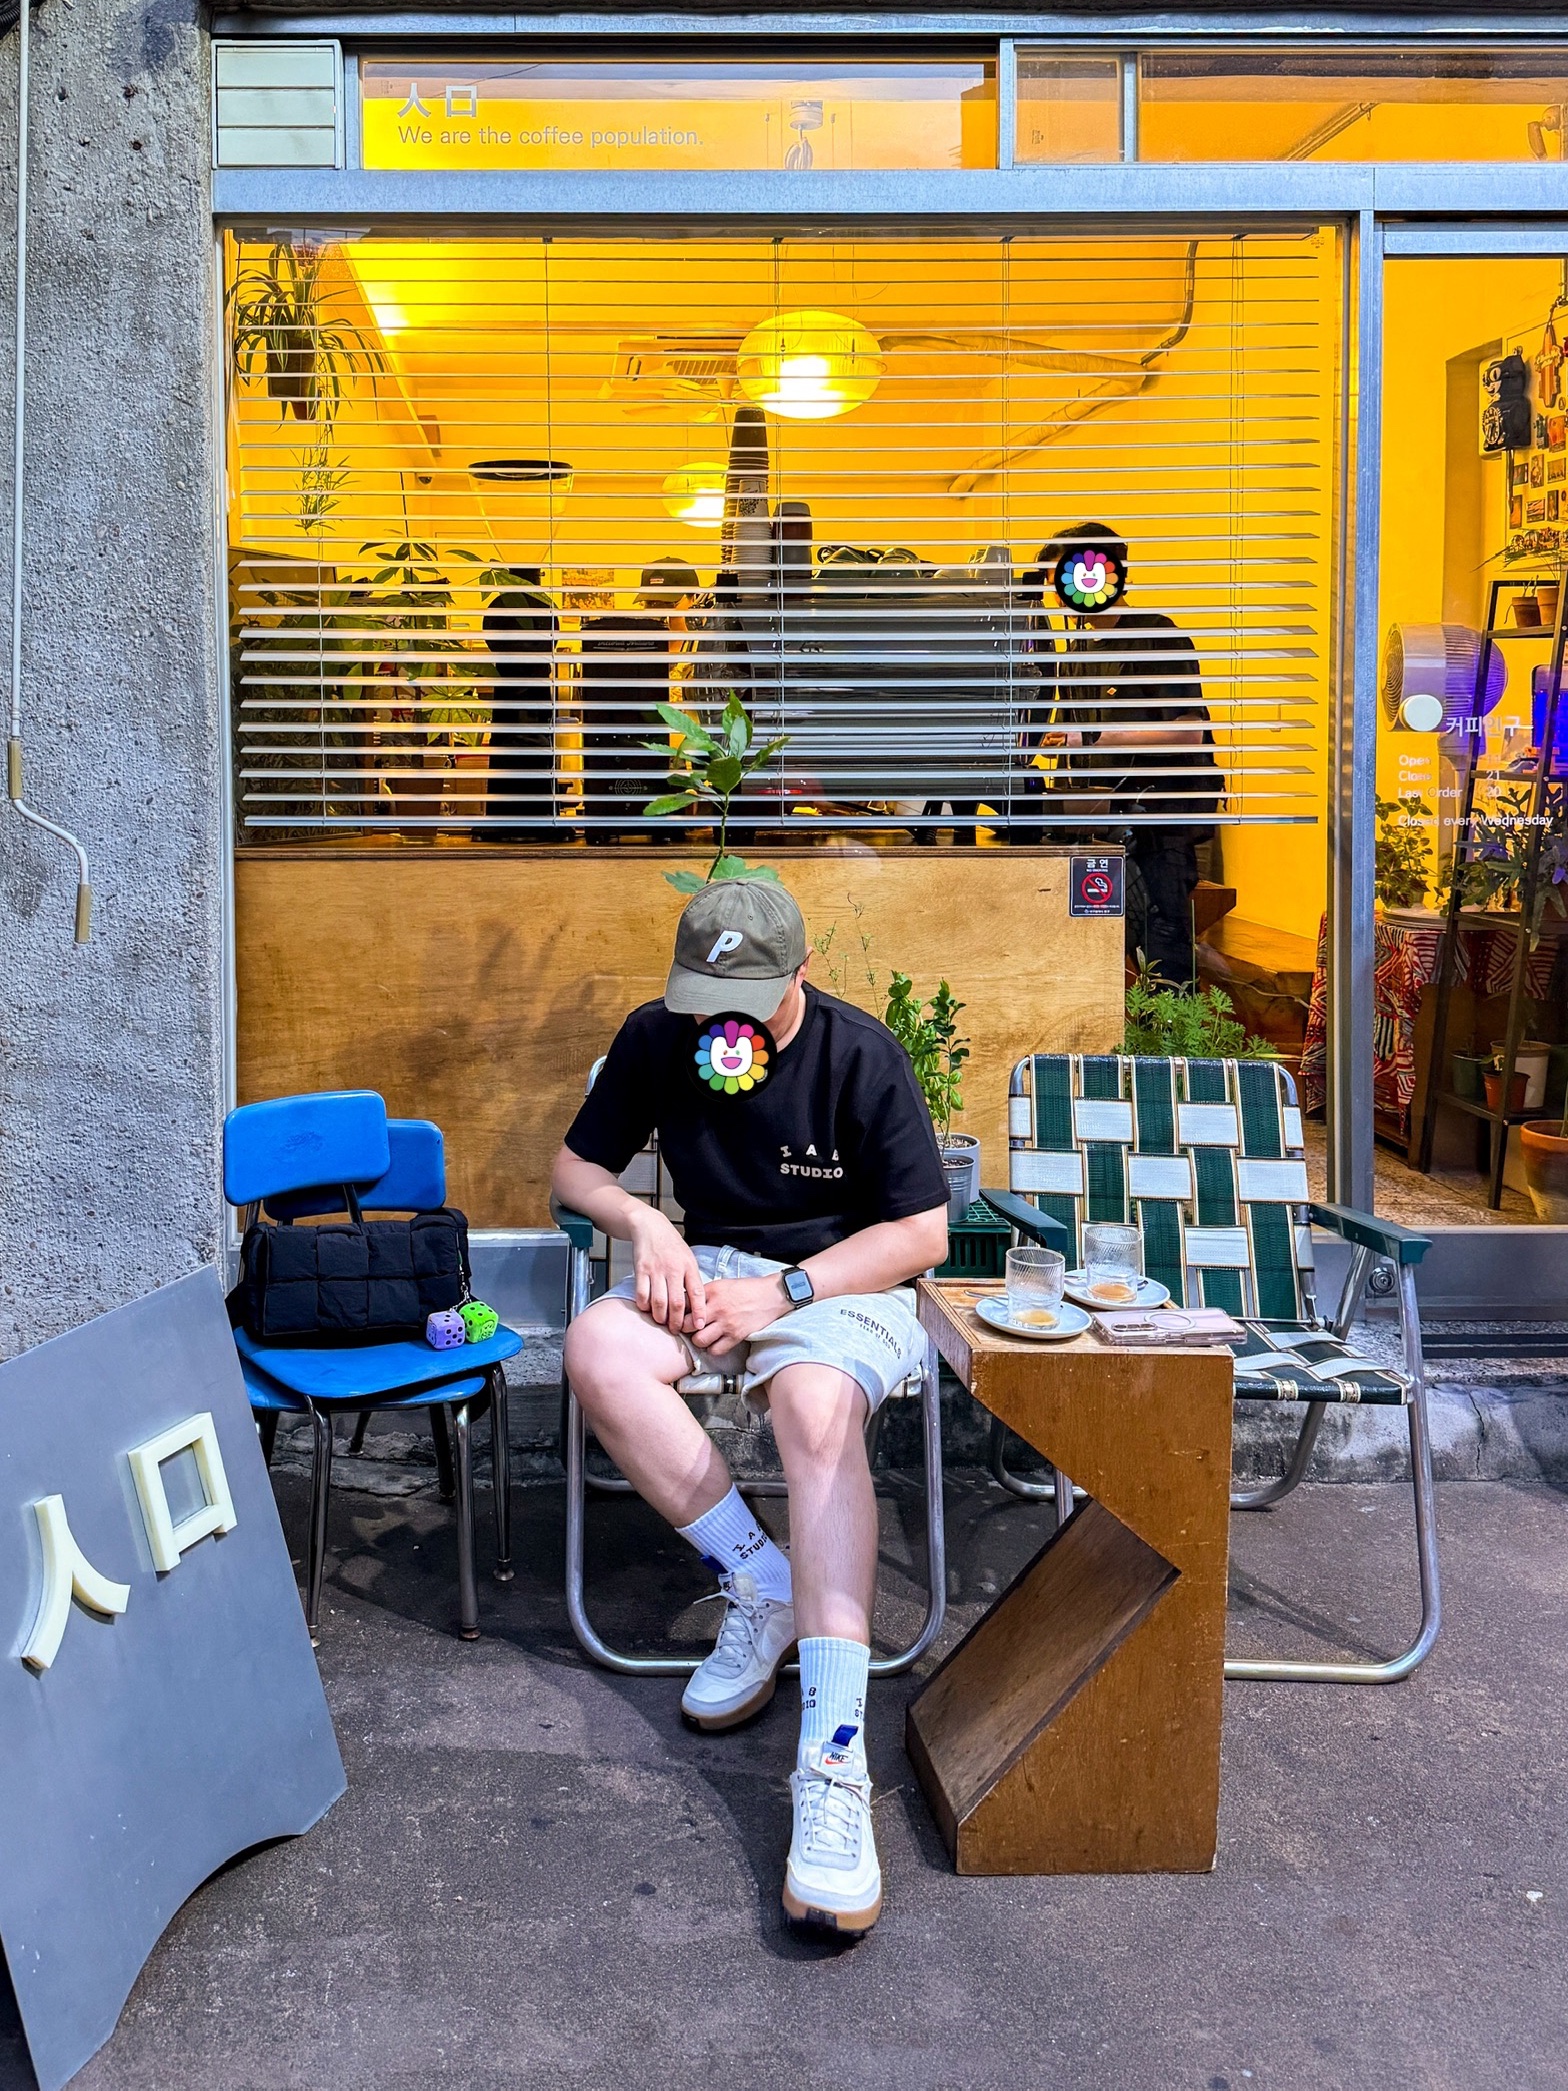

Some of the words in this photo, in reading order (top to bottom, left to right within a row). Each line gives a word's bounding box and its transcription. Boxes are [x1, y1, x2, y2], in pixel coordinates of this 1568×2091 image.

[397, 82, 478, 118] 人口
[397, 125, 433, 144] We
[440, 131, 471, 144] are
[478, 125, 512, 144] the
[519, 125, 584, 144] coffee
[591, 125, 704, 149] population.
[1445, 715, 1522, 738] 커피인구
[1486, 770, 1501, 781] 21
[1428, 786, 1463, 798] Order
[1398, 814, 1440, 827] Closed
[1443, 816, 1476, 829] every
[1480, 814, 1554, 827] Wednesday
[706, 930, 743, 963] P
[780, 1163, 844, 1179] STUDIO
[840, 1308, 902, 1360] ESSENTIALS
